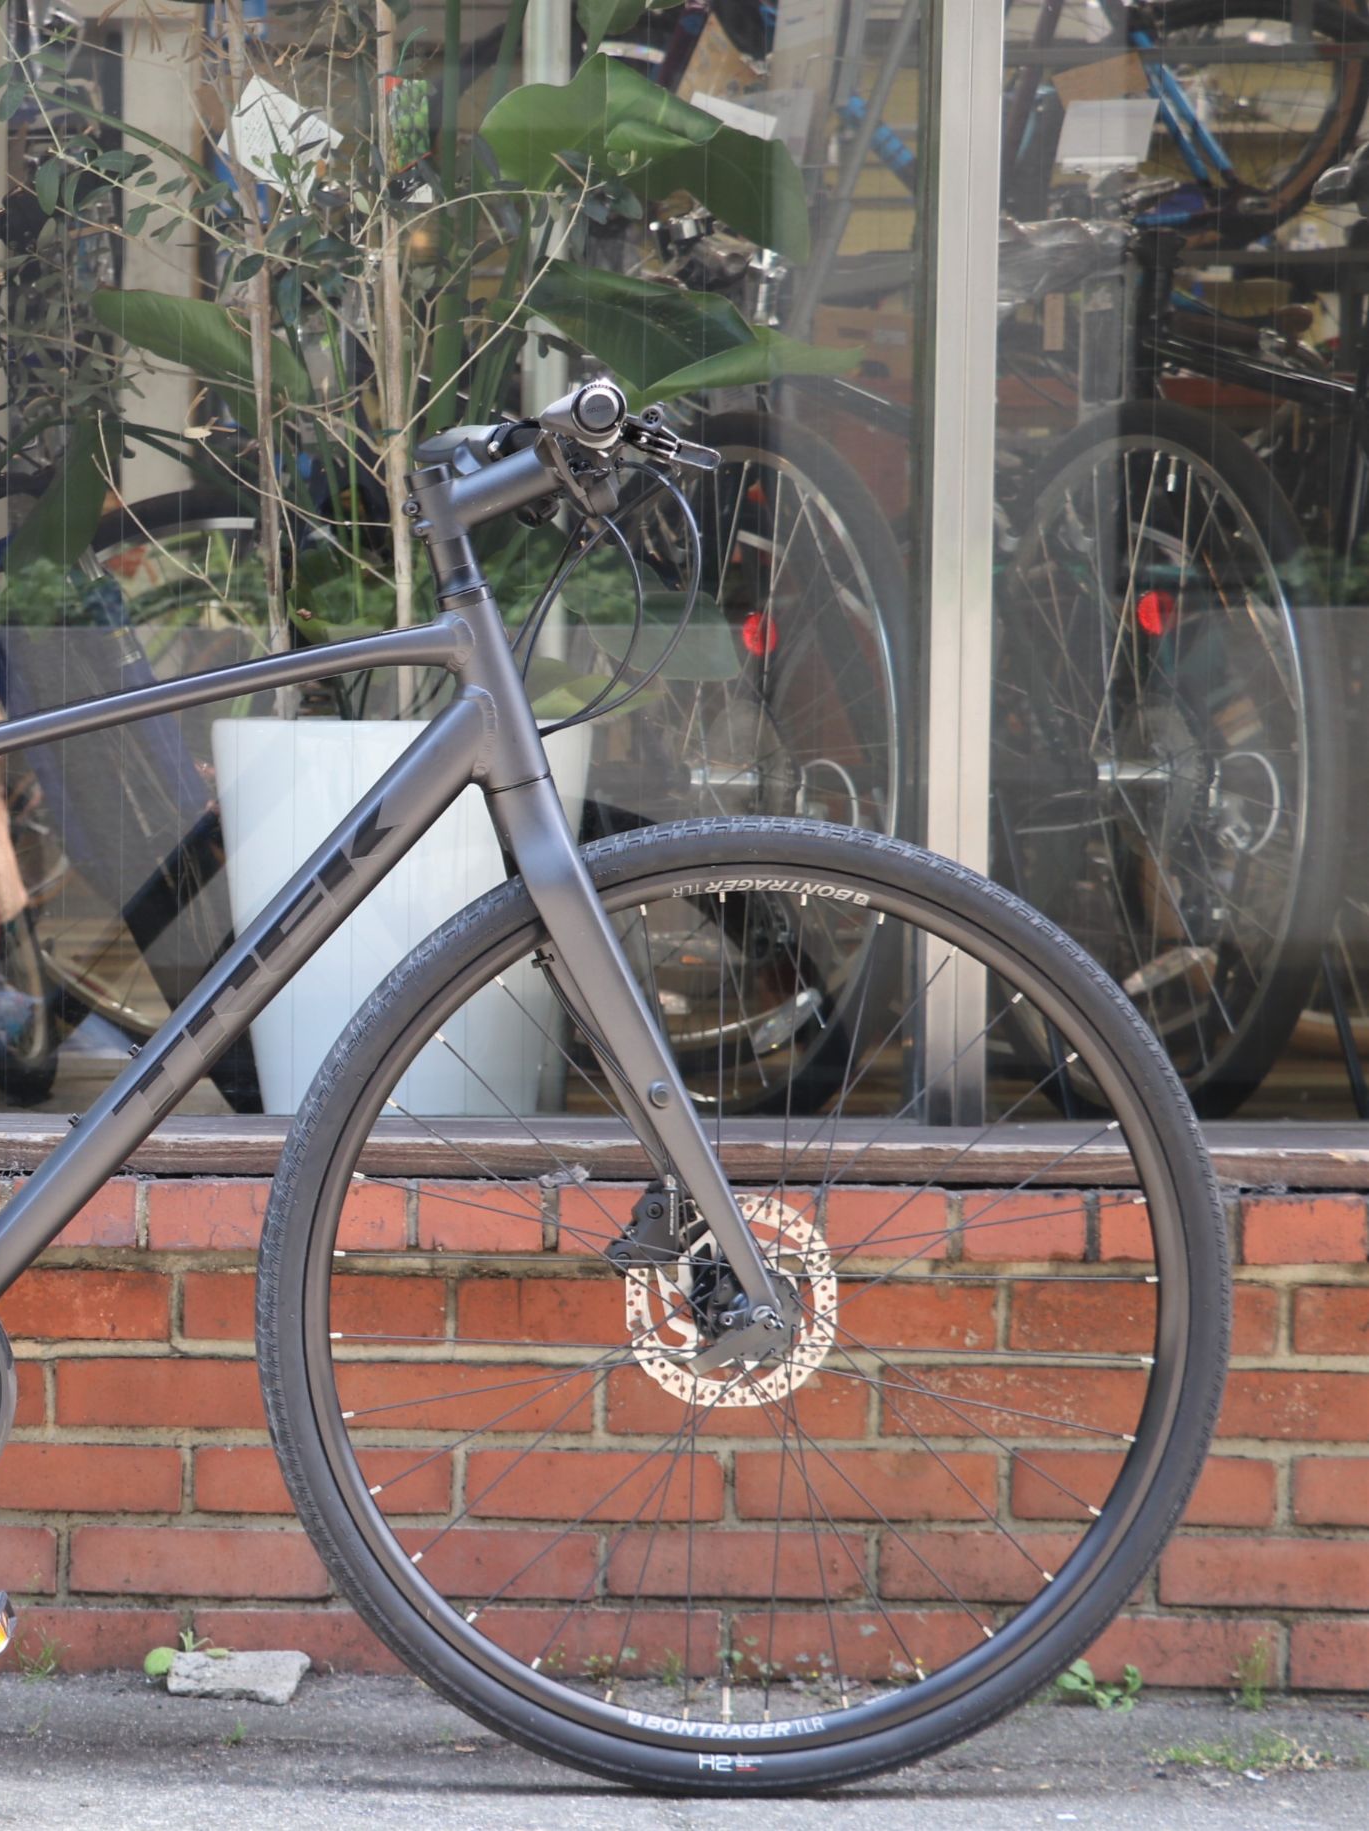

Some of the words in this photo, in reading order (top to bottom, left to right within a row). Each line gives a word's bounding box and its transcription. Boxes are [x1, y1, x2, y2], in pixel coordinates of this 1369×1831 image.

[672, 884, 702, 898] TLR
[705, 878, 855, 901] BONTRAGER
[643, 1716, 792, 1739] BONTRAGER
[791, 1716, 826, 1735] TLR
[698, 1752, 733, 1771] H2
